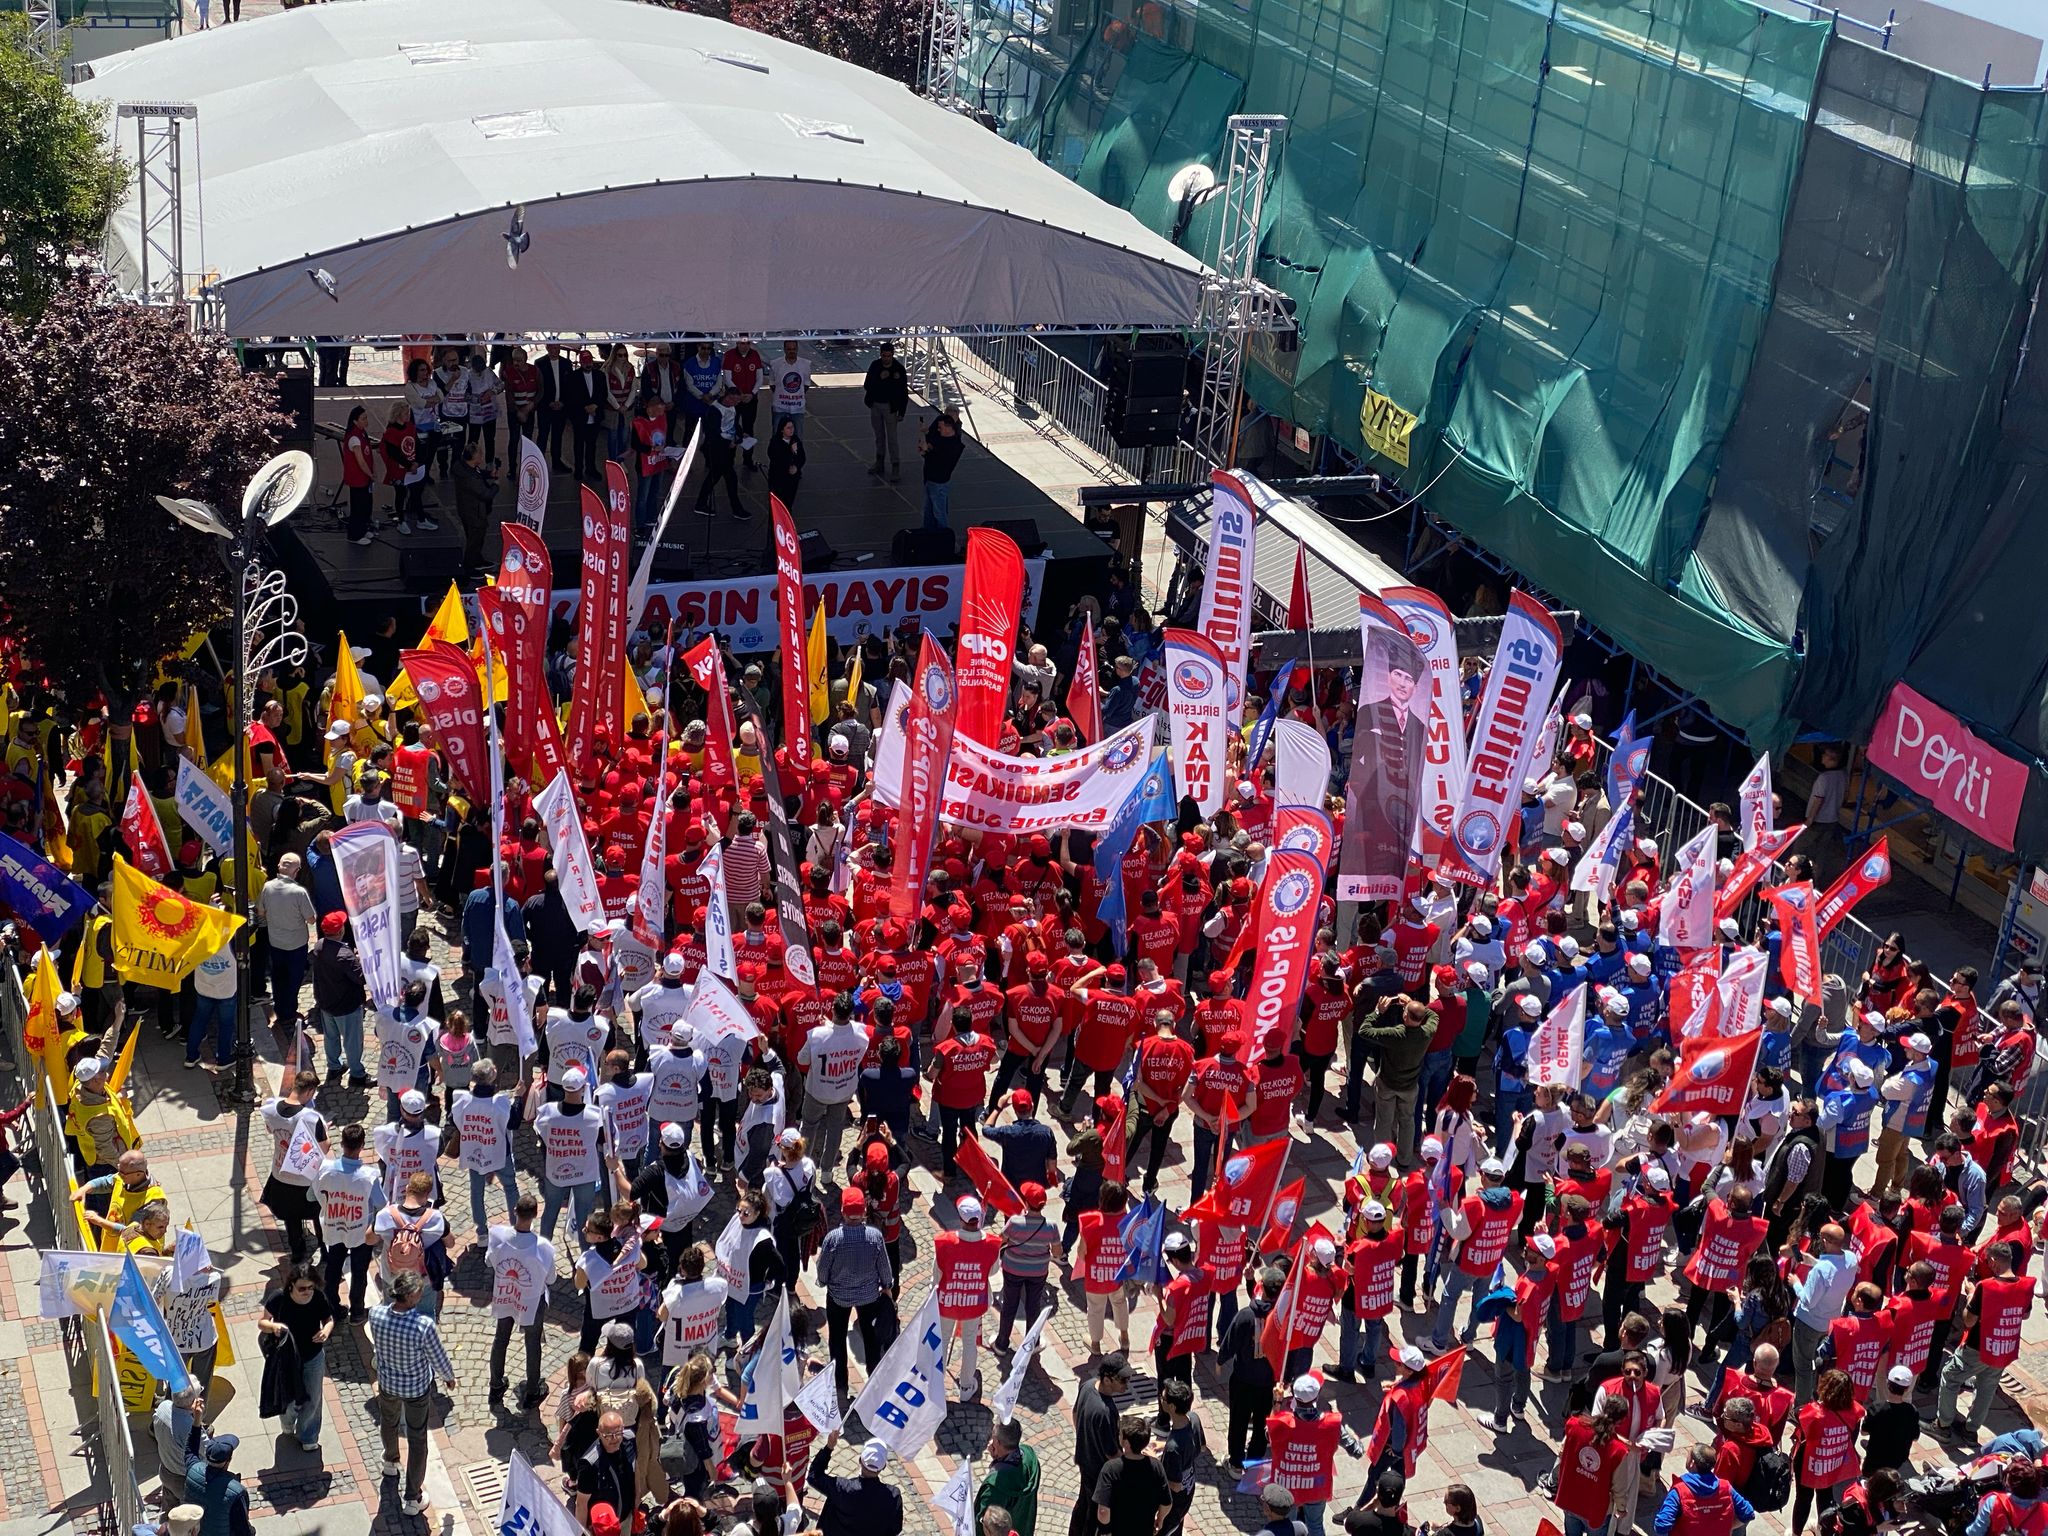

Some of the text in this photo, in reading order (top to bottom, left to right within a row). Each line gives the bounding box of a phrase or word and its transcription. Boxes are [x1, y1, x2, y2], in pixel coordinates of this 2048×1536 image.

[132, 105, 187, 115] M&ESS MUSIC
[1260, 119, 1279, 128] MUSIC
[803, 575, 950, 620] MAYIS
[738, 635, 764, 644] KESK
[681, 875, 703, 885] DİSK
[680, 885, 709, 896] GENEL
[1141, 928, 1174, 941] TEZ-KOOP-İ
[1828, 931, 1860, 962] POLİS
[829, 1048, 861, 1058] YAŞASIN
[818, 1053, 859, 1077] 1 MAYIS
[617, 1095, 643, 1110] EMEK
[465, 1114, 492, 1124] EMEK
[616, 1106, 646, 1121] EYLEM
[551, 1127, 581, 1137] EMEK
[549, 1138, 584, 1147] EYLEM
[548, 1147, 587, 1158] DİRENİŞ
[327, 1204, 362, 1222] MAYIS
[1485, 1219, 1508, 1229] EMEK
[1714, 1233, 1740, 1249] EMEK
[1710, 1241, 1740, 1257] EYLEM
[954, 1262, 981, 1271] EMEK
[603, 1272, 636, 1287] EYLE
[952, 1271, 983, 1280] EYLEM
[497, 1282, 521, 1301] TÜM
[946, 1281, 986, 1291] DİRENİŞ
[2002, 1306, 2023, 1316] EMEK
[671, 1317, 682, 1342] 1
[1856, 1341, 1880, 1352] EMEK
[1824, 1425, 1848, 1437] EMEK
[1820, 1433, 1849, 1446] EYLEM
[1287, 1441, 1317, 1453] EMEK
[1285, 1450, 1318, 1462] EYLEM
[1280, 1460, 1321, 1472] DİRENİŞ
